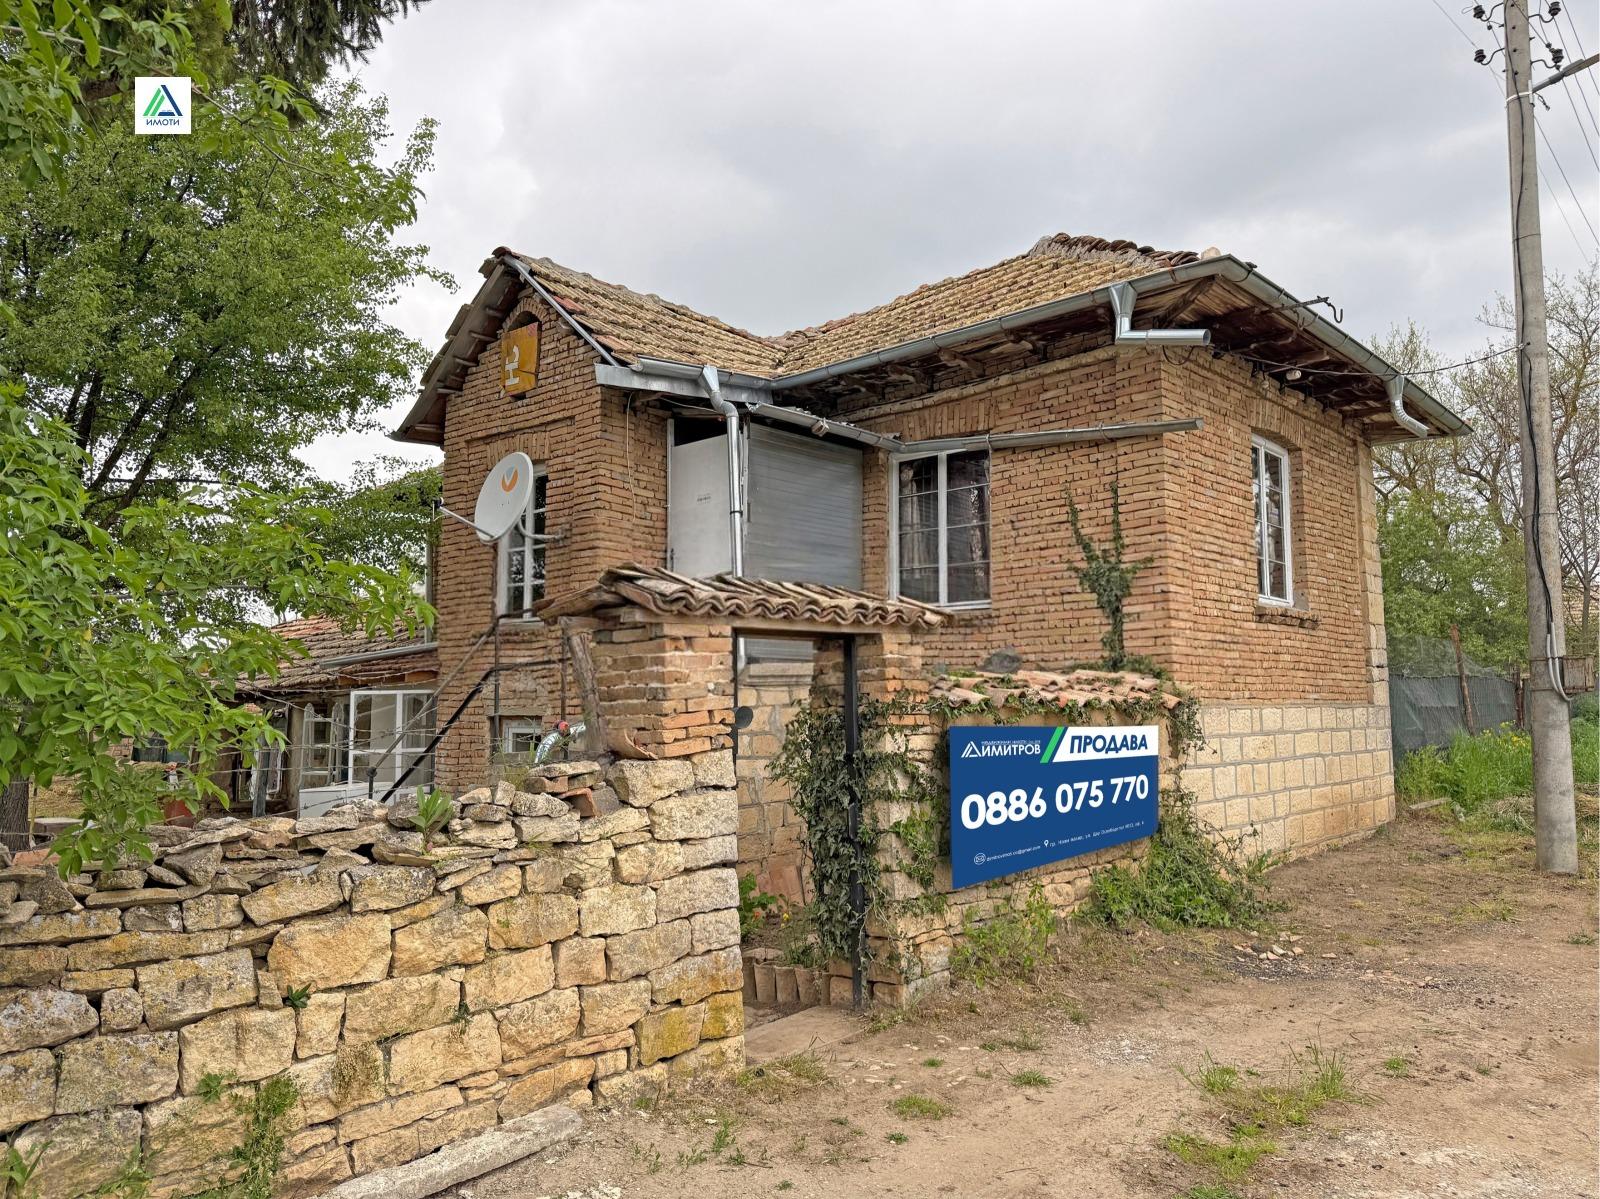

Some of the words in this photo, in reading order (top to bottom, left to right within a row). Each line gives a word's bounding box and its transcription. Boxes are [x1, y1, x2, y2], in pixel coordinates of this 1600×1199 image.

[1069, 734, 1148, 754] ПРОДАВА
[961, 786, 1047, 830] 0886
[1055, 780, 1104, 814] 075
[1110, 774, 1149, 804] 770
